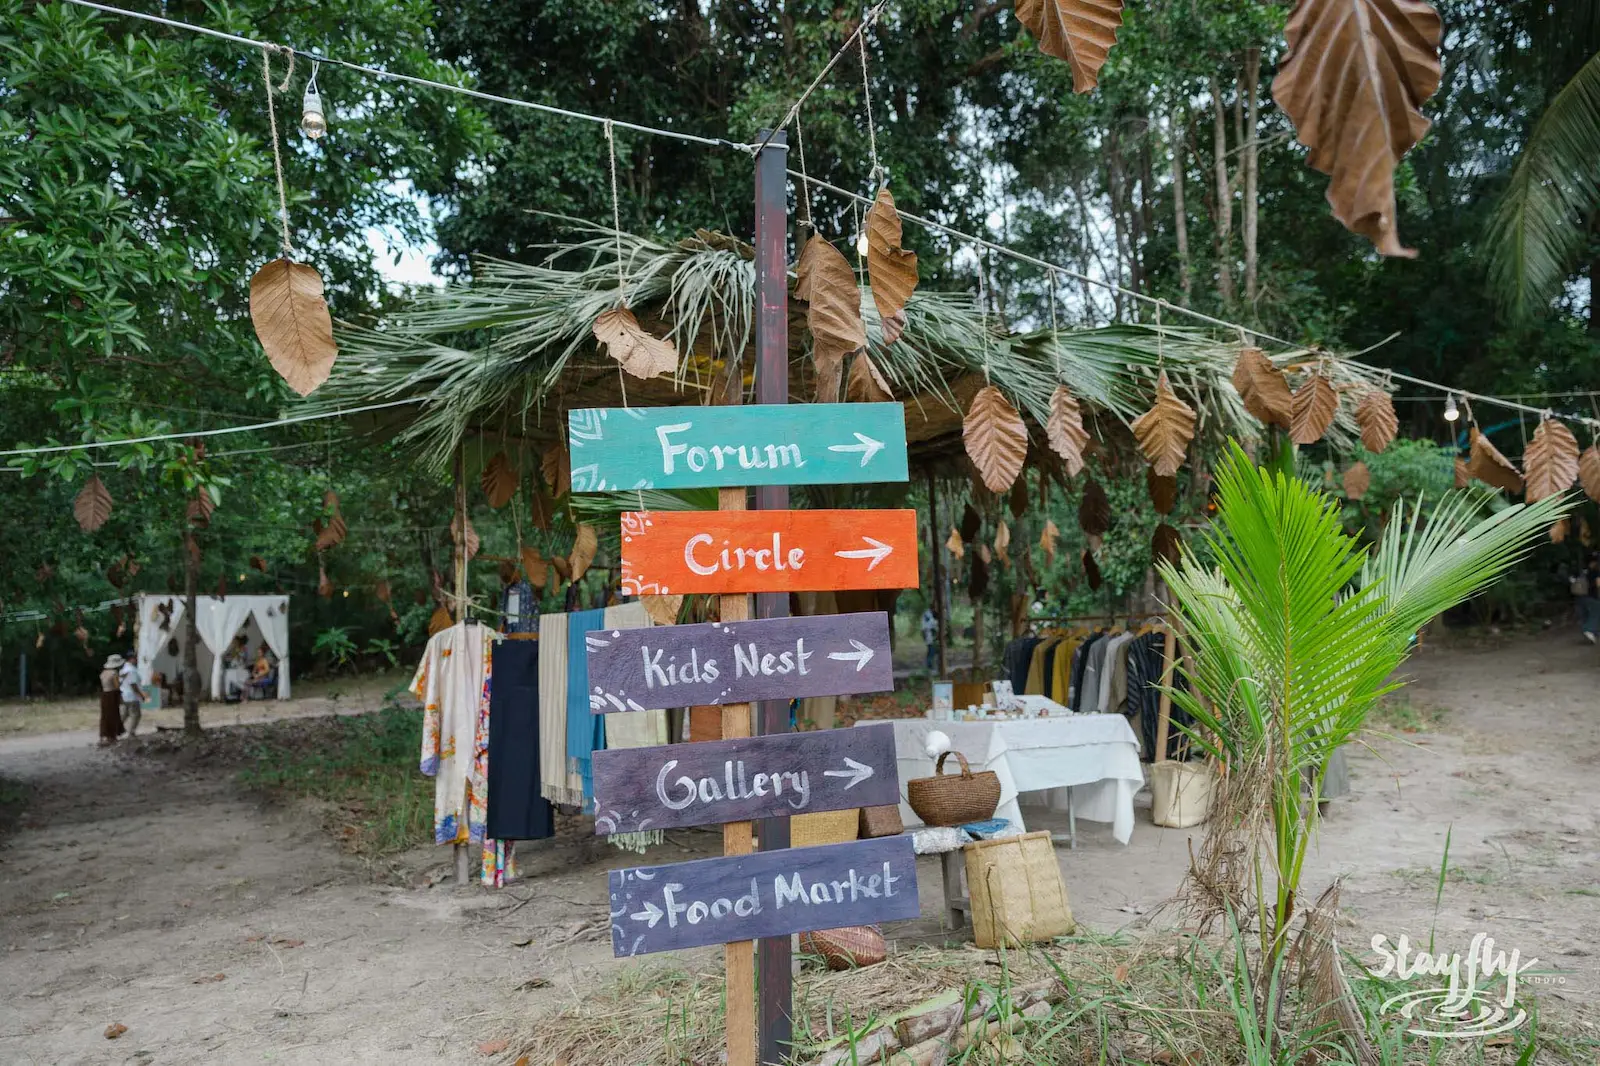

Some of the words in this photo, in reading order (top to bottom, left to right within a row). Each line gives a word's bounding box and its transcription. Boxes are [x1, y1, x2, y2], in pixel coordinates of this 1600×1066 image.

[656, 421, 808, 475] Forum
[684, 532, 806, 575] Circle
[641, 645, 721, 689] Kids
[733, 638, 814, 680] Nest
[656, 760, 810, 810] Gallery
[663, 877, 763, 928] Food
[774, 861, 900, 909] Market
